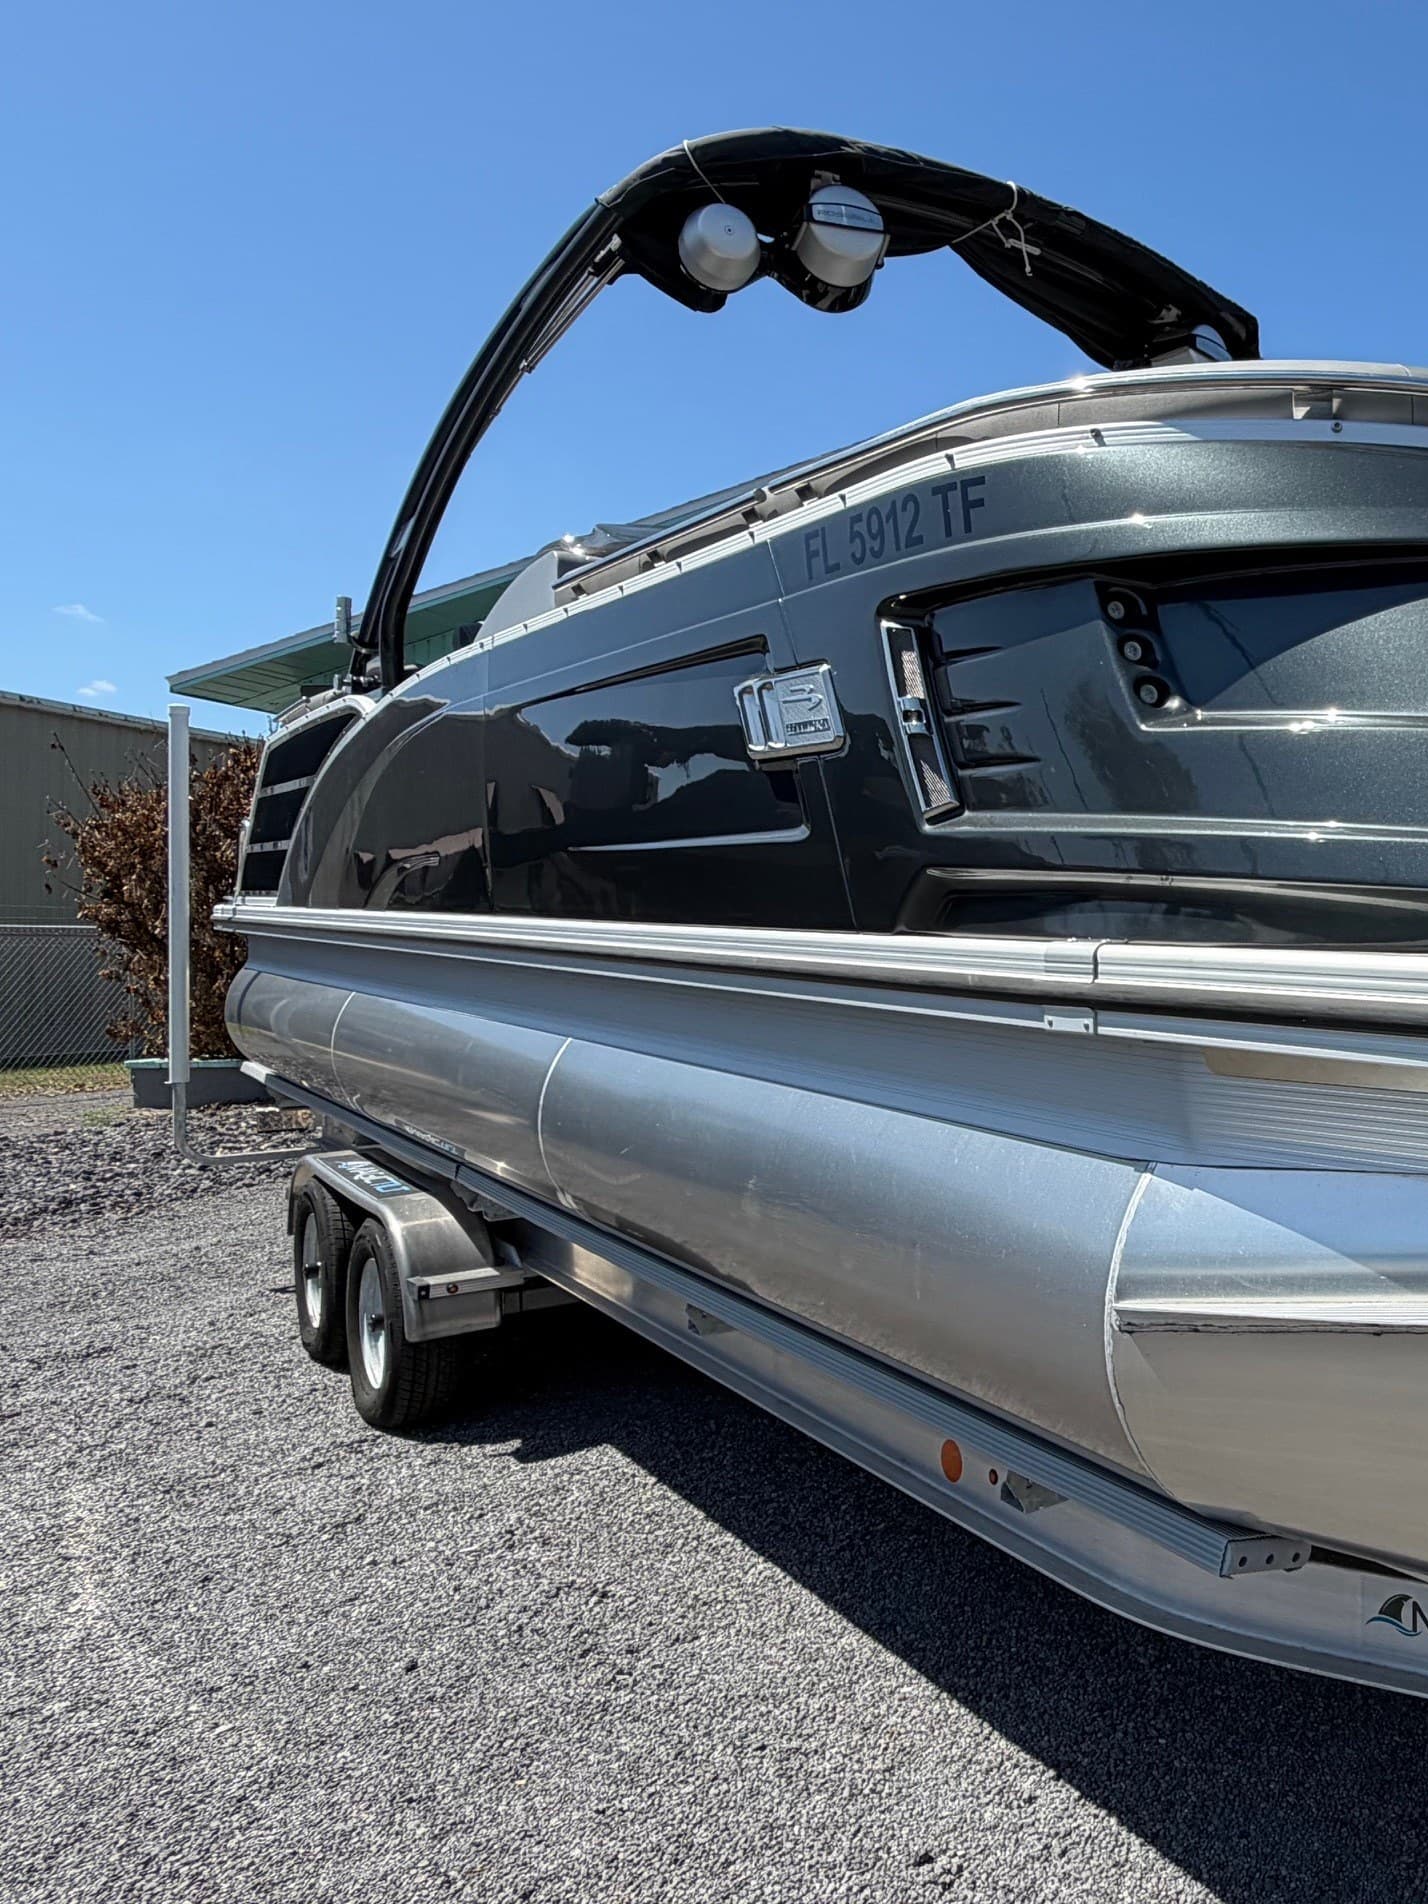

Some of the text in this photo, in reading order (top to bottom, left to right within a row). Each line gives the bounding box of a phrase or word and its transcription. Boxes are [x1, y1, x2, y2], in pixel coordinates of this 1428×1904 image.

[803, 475, 986, 581] FL 5912 TF
